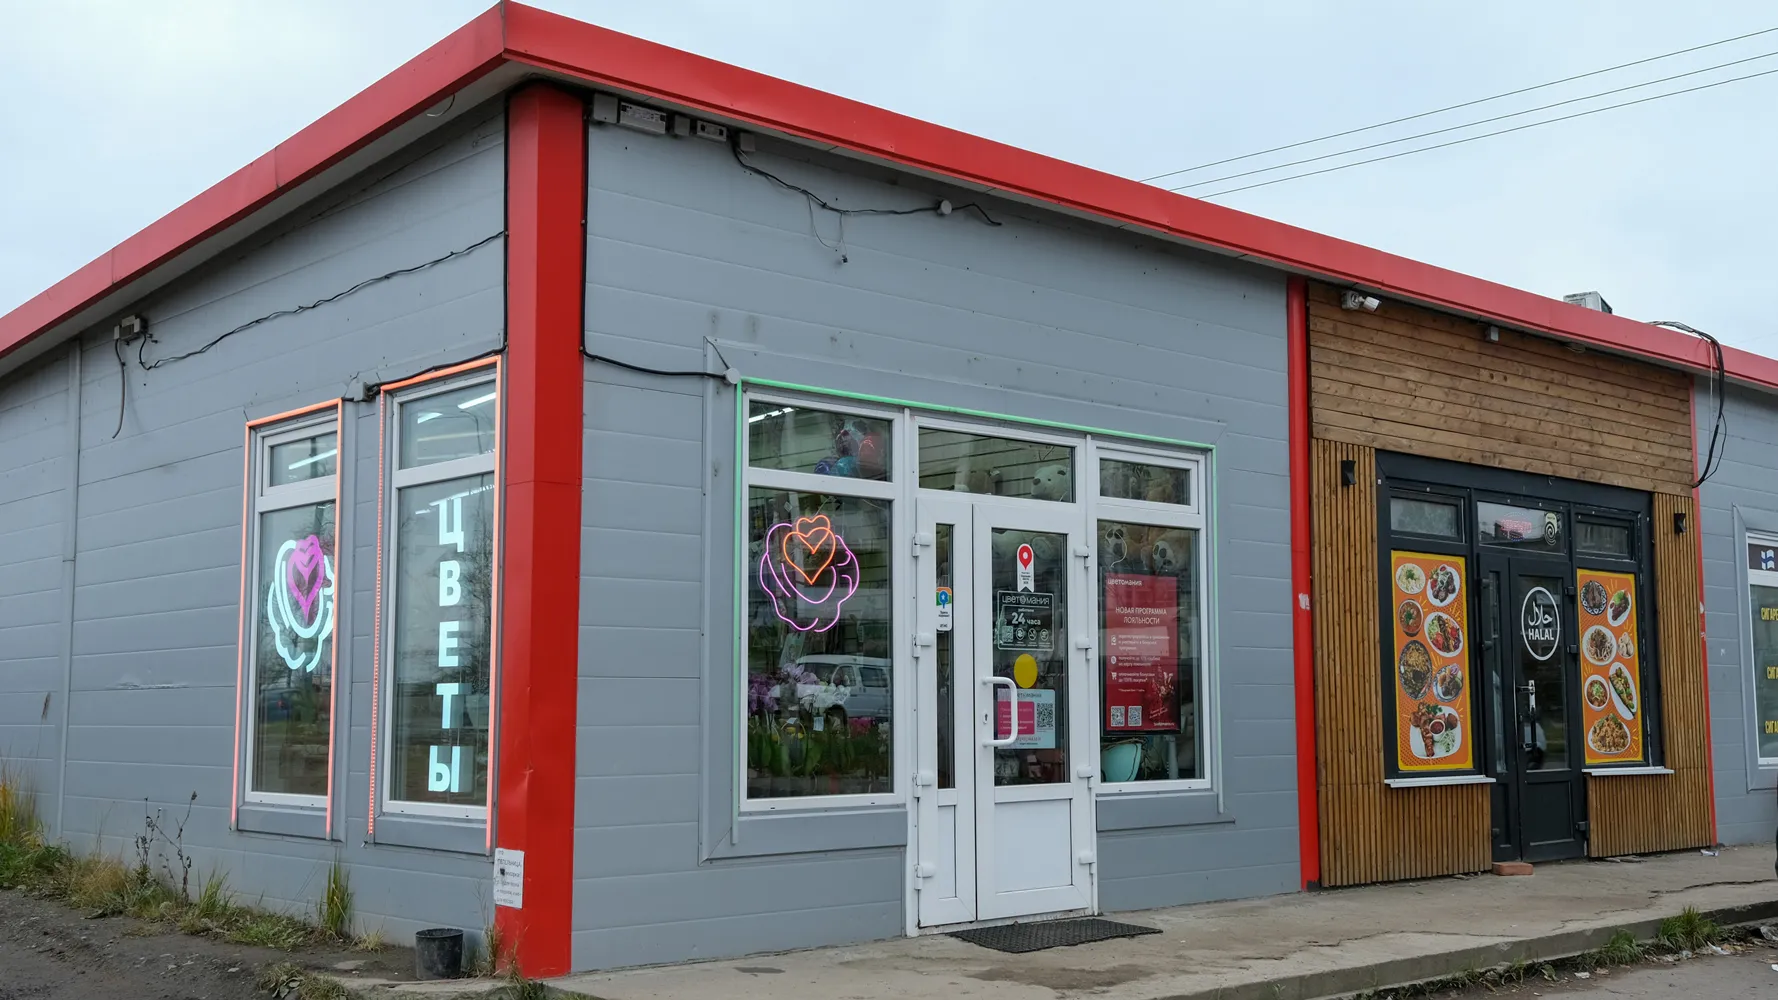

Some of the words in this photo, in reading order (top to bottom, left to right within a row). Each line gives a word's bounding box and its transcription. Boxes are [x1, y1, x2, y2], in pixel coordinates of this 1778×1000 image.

[1011, 612, 1026, 625] 24
[1528, 601, 1553, 626] حلال
[1528, 628, 1555, 641] HALAL
[428, 496, 465, 793] ЦВЕТЫ
